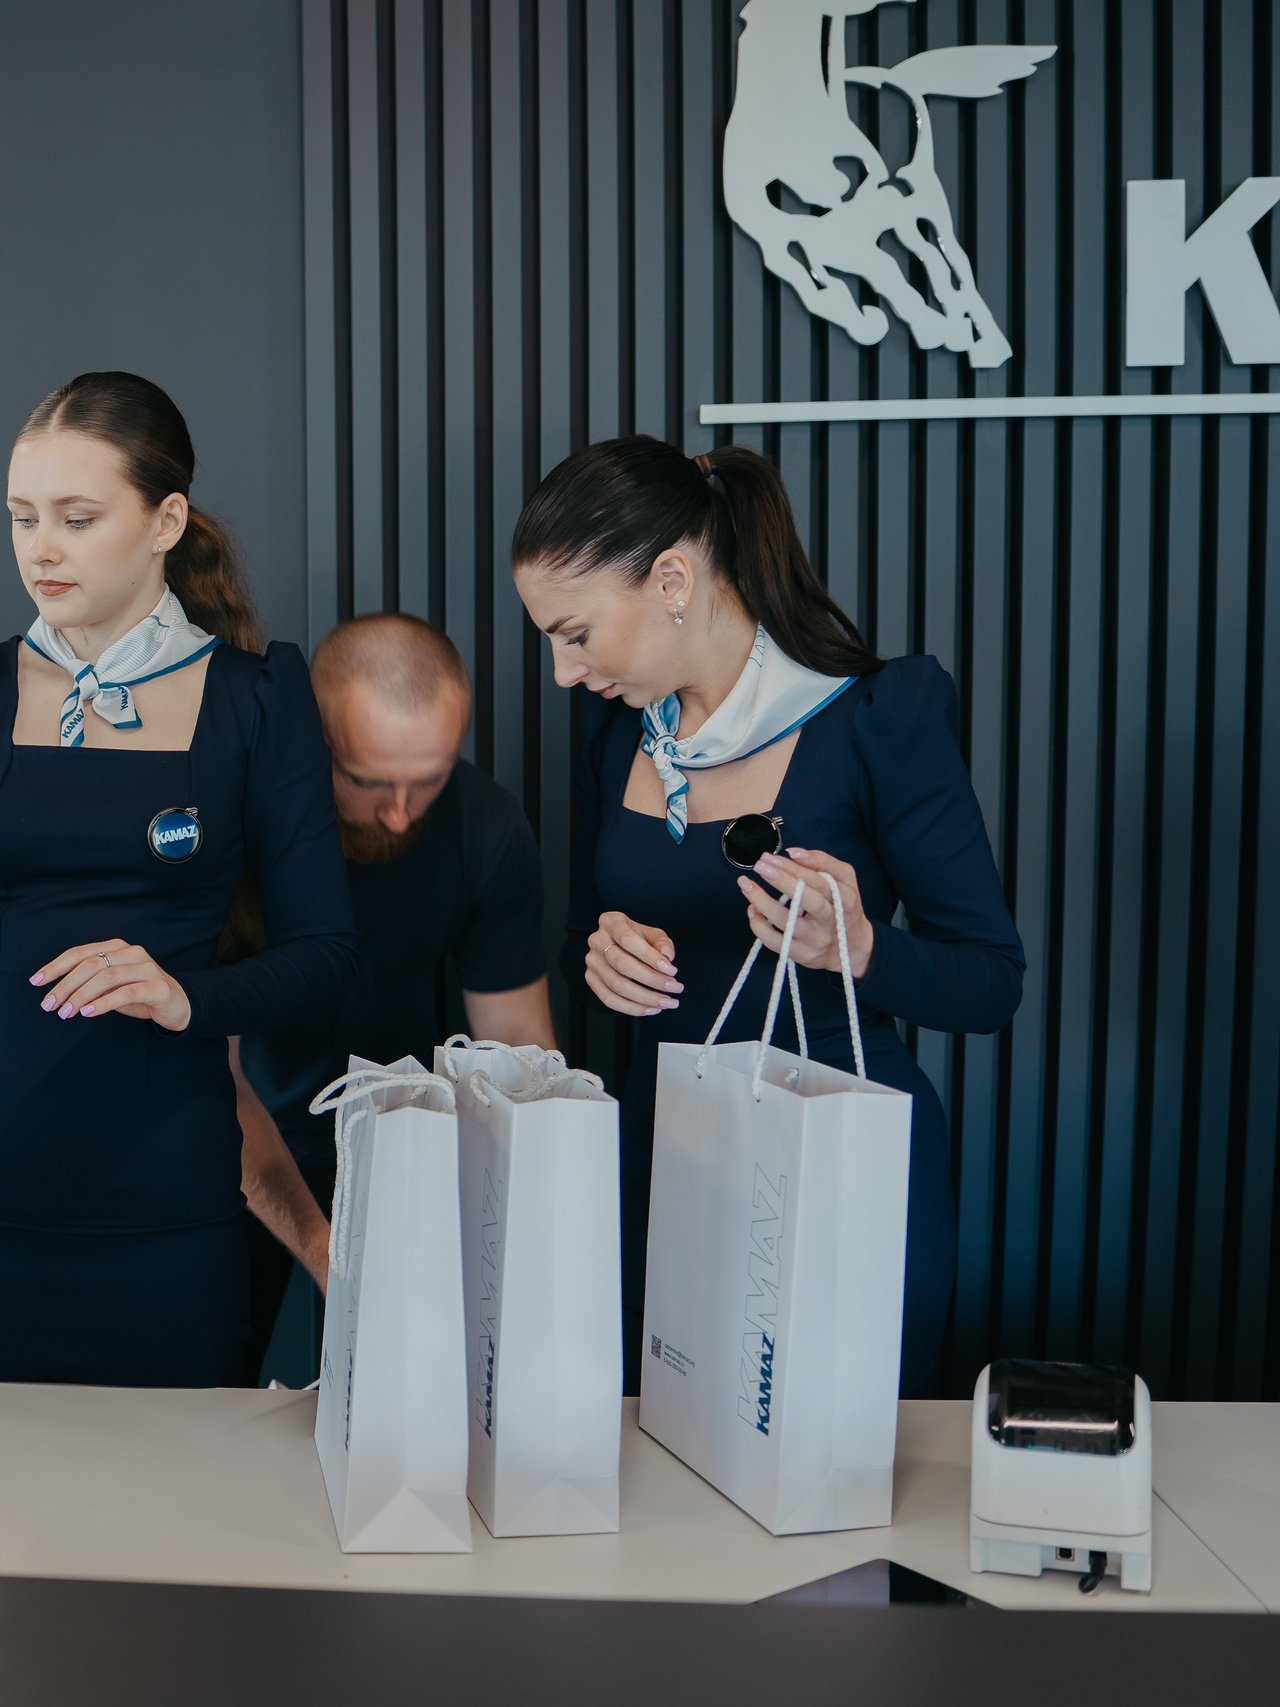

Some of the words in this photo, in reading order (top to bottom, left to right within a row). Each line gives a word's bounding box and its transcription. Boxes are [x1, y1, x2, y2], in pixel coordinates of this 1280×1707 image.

[155, 825, 197, 846] KAMAZ
[737, 1162, 787, 1432] KAMAZ
[756, 1332, 775, 1437] KAMAZ
